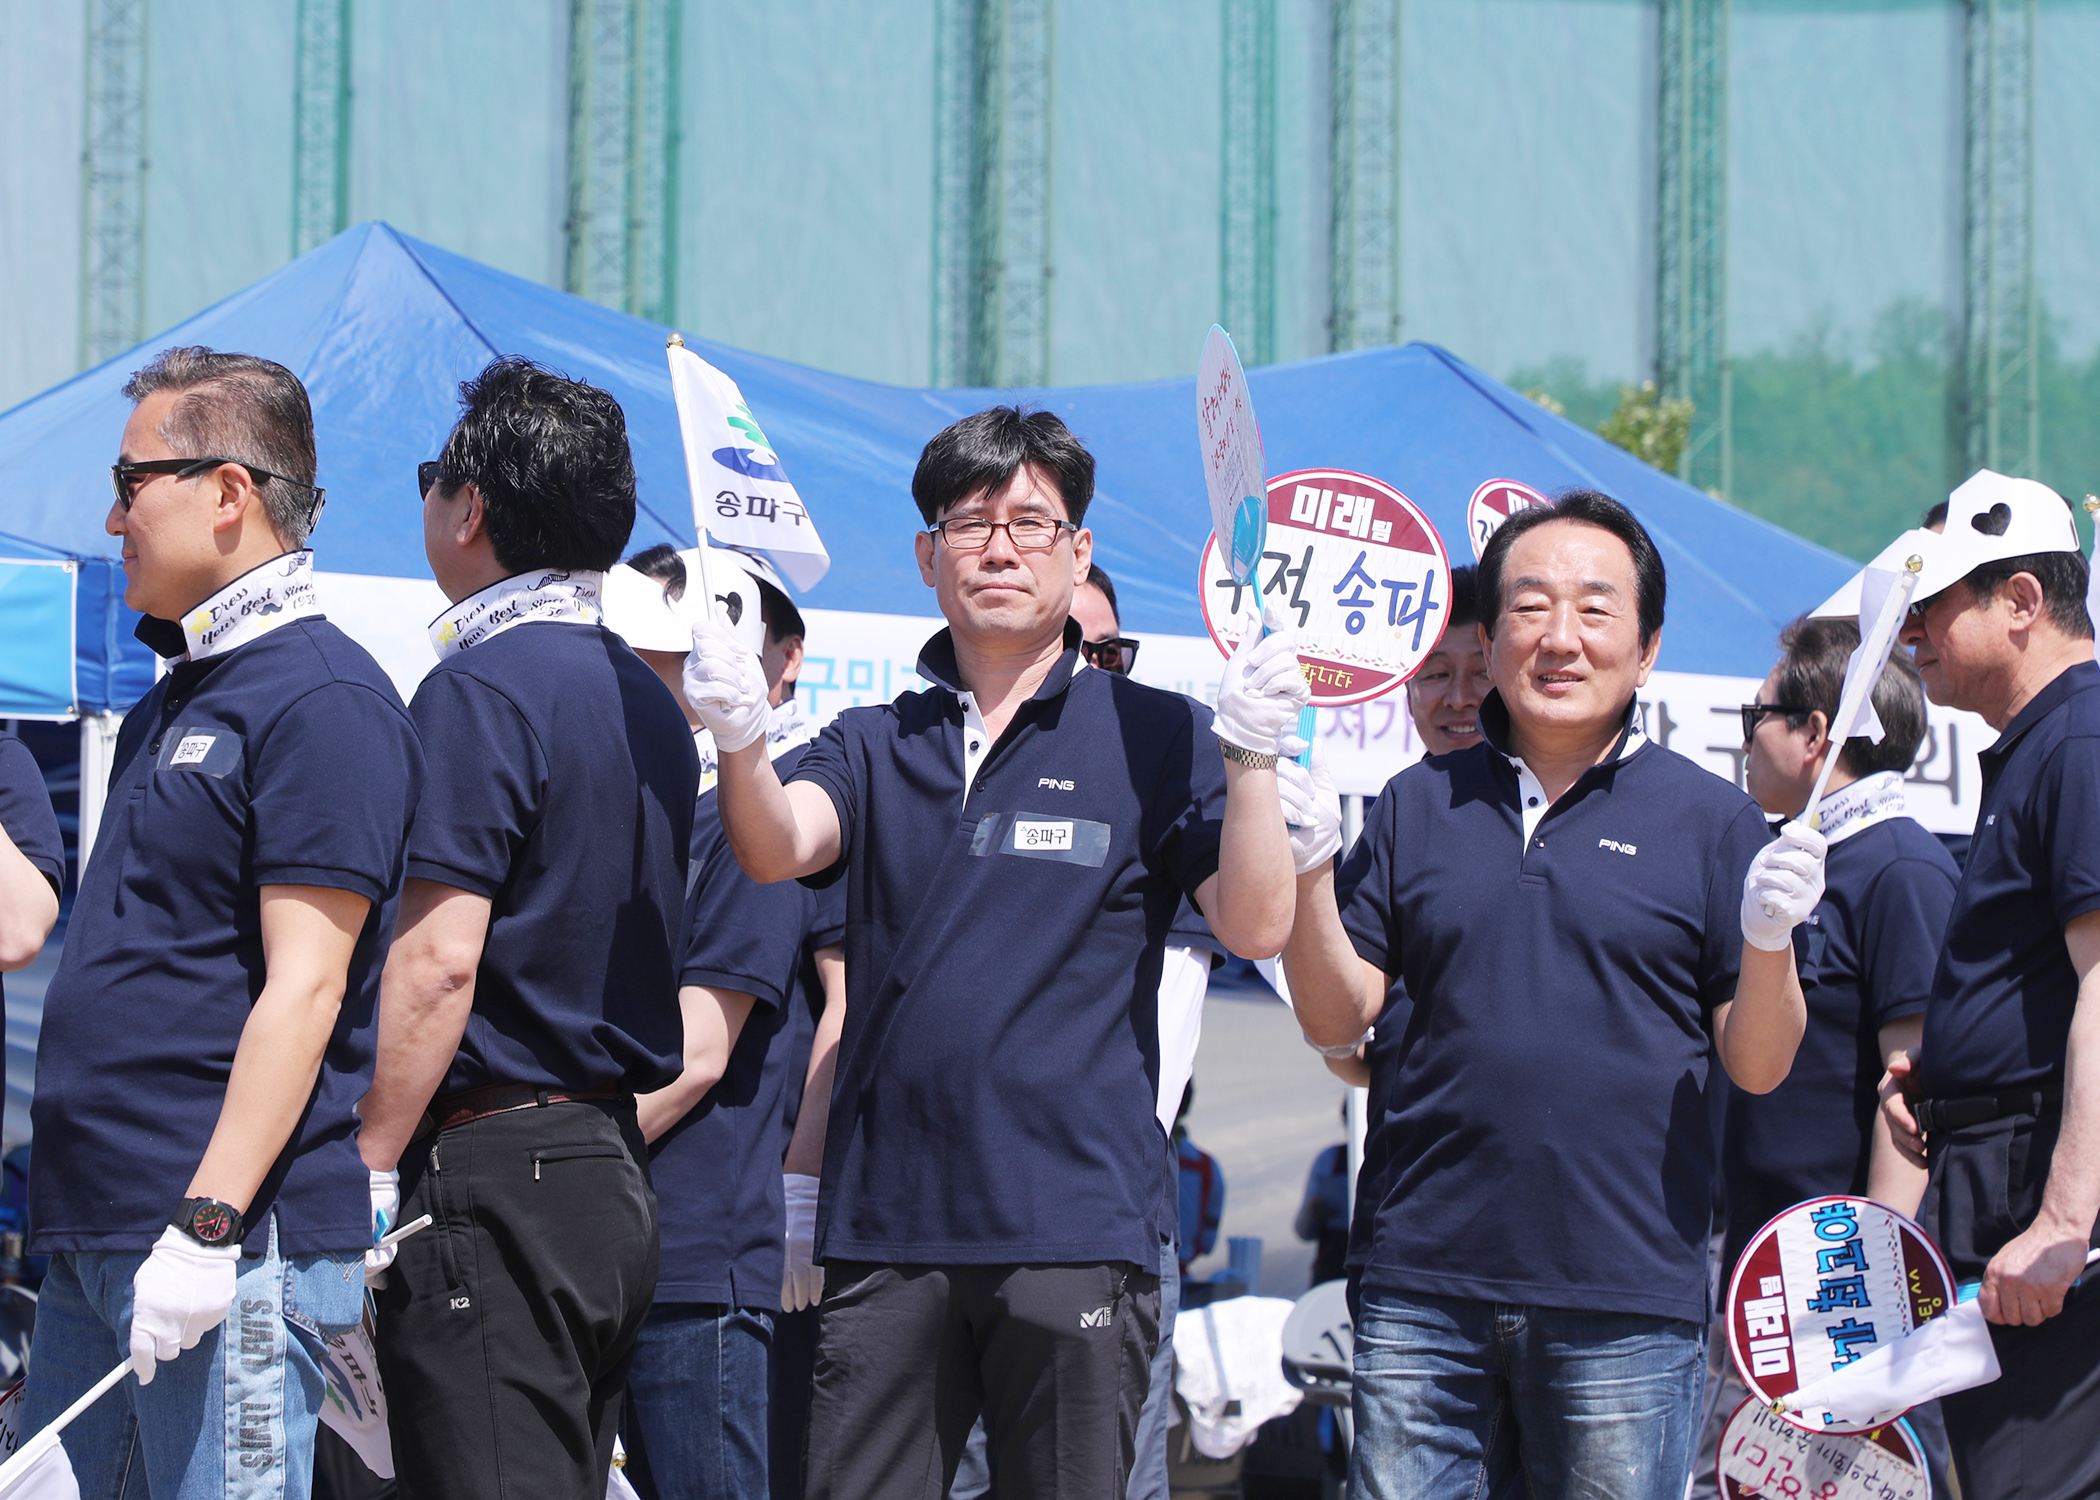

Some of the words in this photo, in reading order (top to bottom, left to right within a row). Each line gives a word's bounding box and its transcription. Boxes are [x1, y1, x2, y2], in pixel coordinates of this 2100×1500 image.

[715, 490, 808, 526] 송파구
[1290, 484, 1393, 544] 미래팀
[209, 588, 248, 624] Dress
[240, 587, 274, 616] Best
[489, 600, 519, 625] Best
[1333, 551, 1440, 652] 송파
[454, 603, 486, 635] Dress
[1037, 777, 1075, 791] PING
[1026, 829, 1067, 845] 송파구
[1598, 838, 1638, 856] PING
[450, 1296, 471, 1310] K2
[1743, 1275, 1790, 1378] 미래팀
